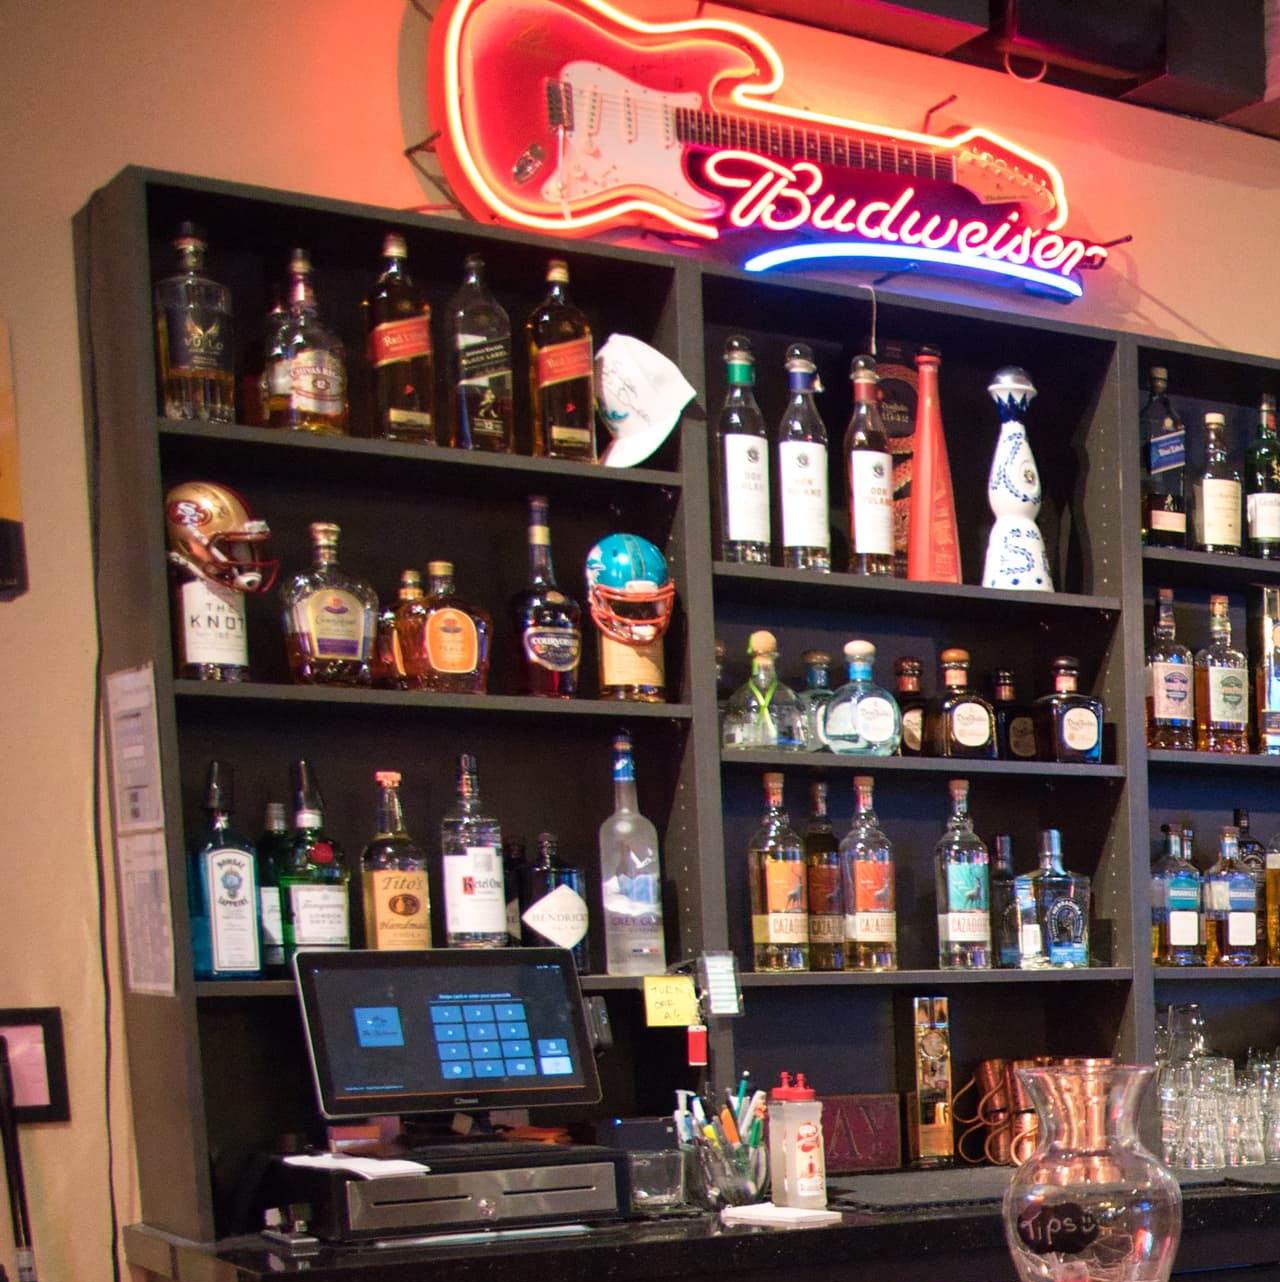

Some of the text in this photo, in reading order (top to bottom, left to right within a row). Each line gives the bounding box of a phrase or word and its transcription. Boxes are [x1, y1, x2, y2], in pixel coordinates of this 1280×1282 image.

[704, 149, 1109, 276] Budweiser
[190, 616, 245, 629] KNOT
[382, 875, 424, 890] Tito's
